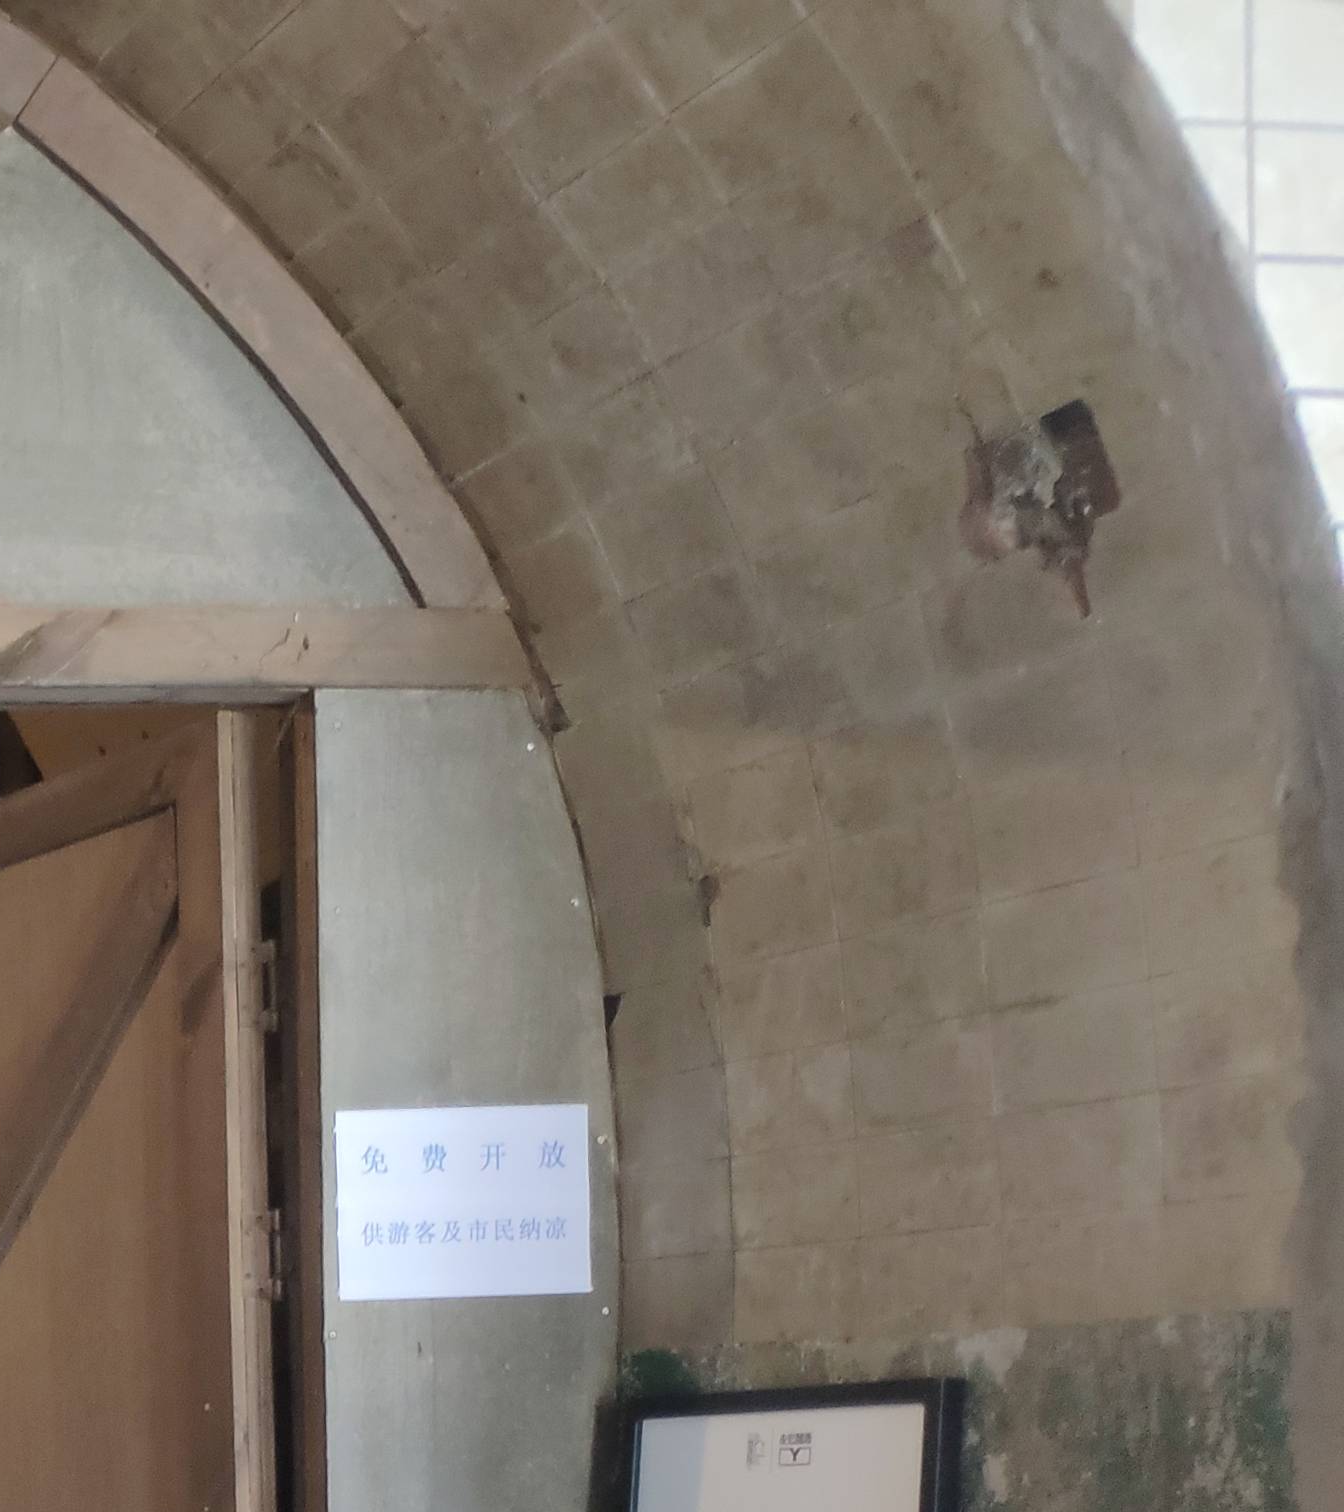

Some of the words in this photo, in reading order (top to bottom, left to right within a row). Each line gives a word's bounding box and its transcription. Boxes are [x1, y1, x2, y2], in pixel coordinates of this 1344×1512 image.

[361, 1140, 567, 1175] 免费开放
[361, 1216, 568, 1248] 供游客及市民纳凉
